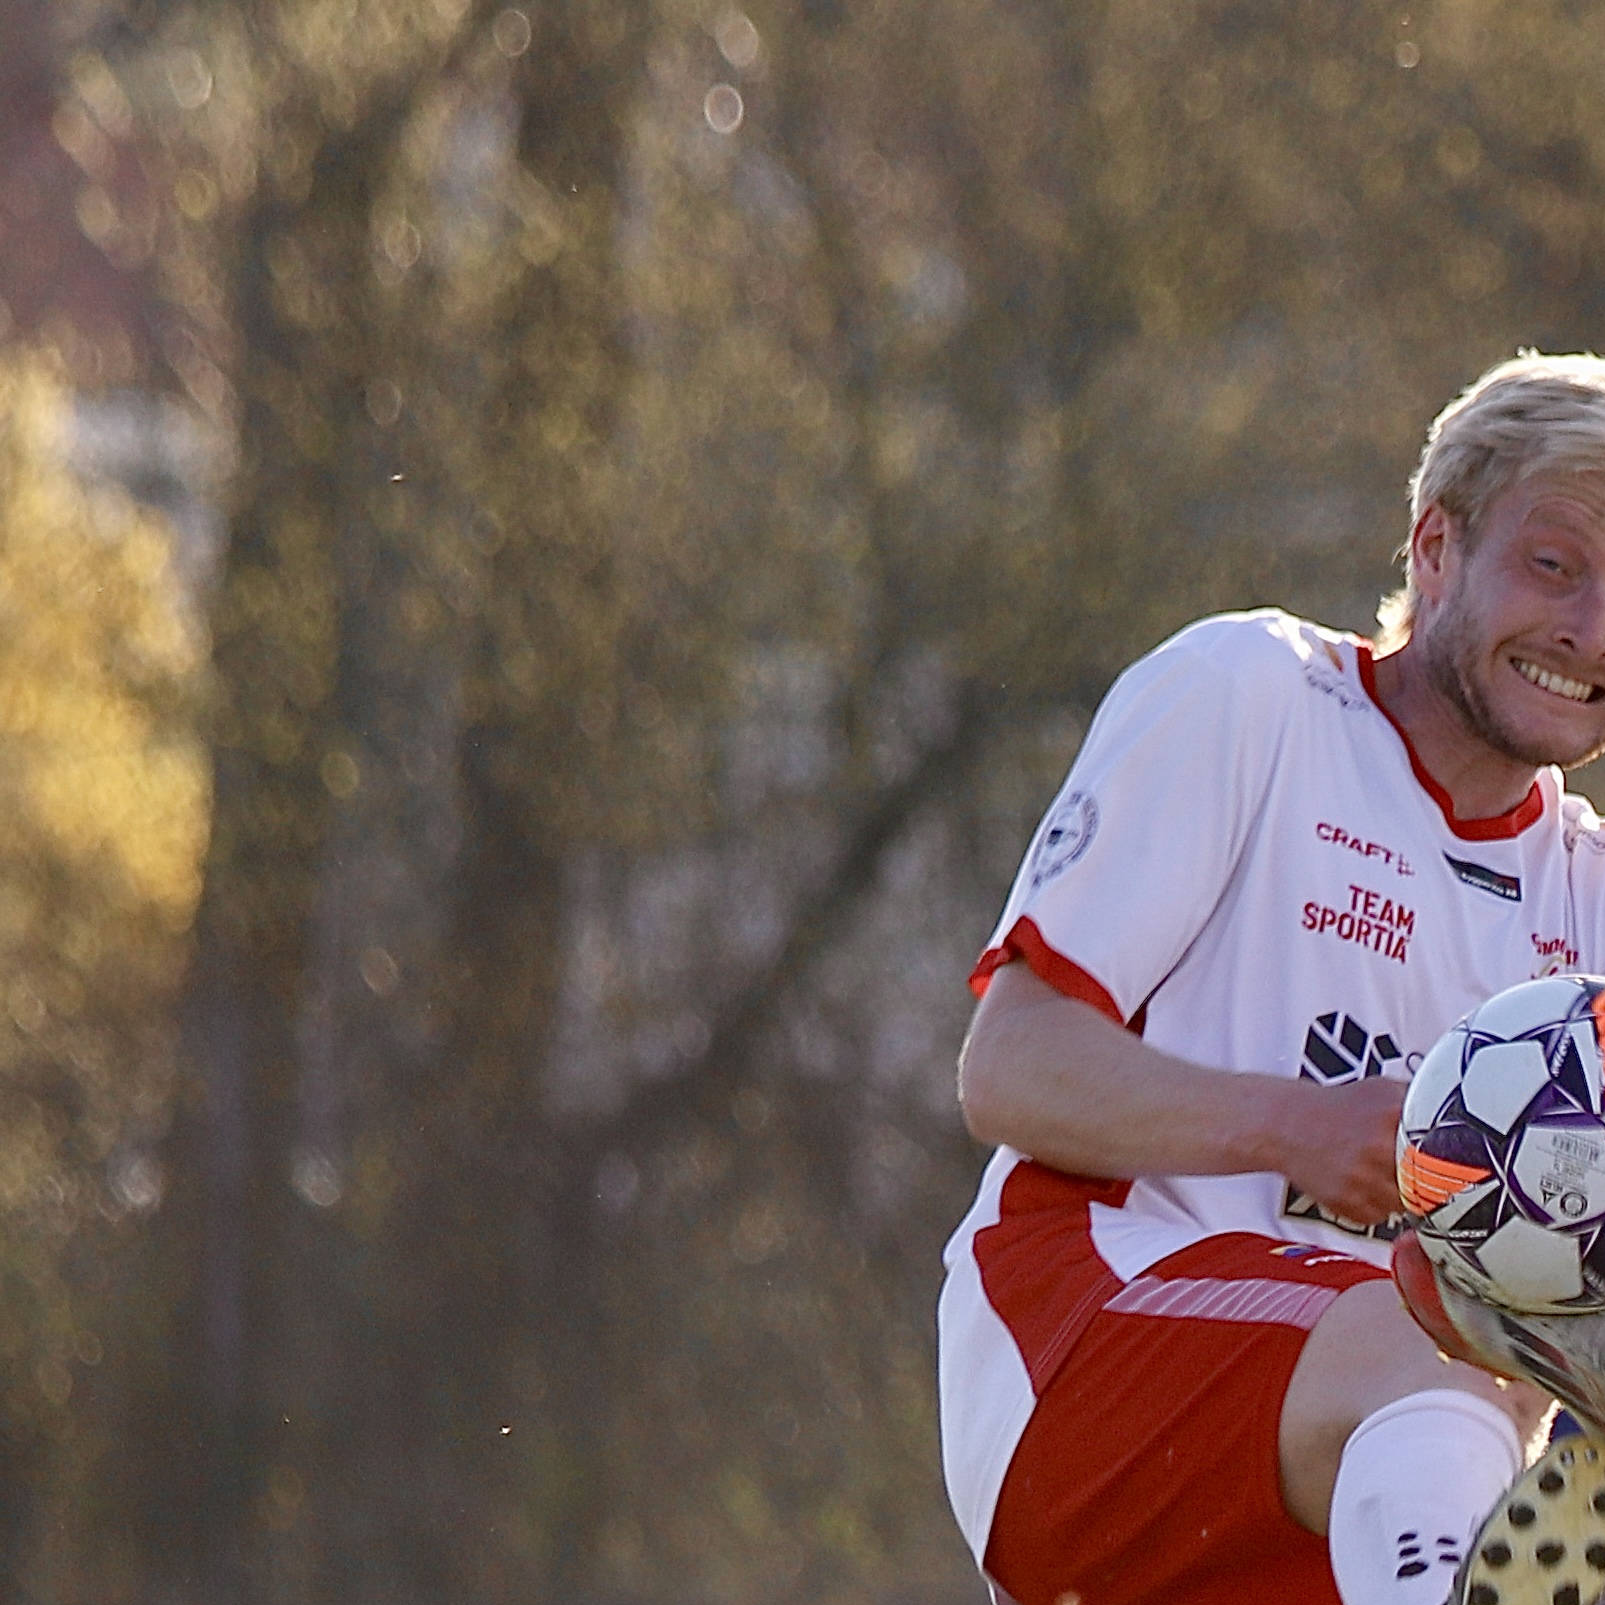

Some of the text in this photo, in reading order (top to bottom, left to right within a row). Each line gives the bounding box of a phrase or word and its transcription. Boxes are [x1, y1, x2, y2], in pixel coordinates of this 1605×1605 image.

[1316, 822, 1393, 865] CRAFT
[1302, 902, 1408, 964] SPORTIA
[1349, 884, 1415, 935] TEAM
